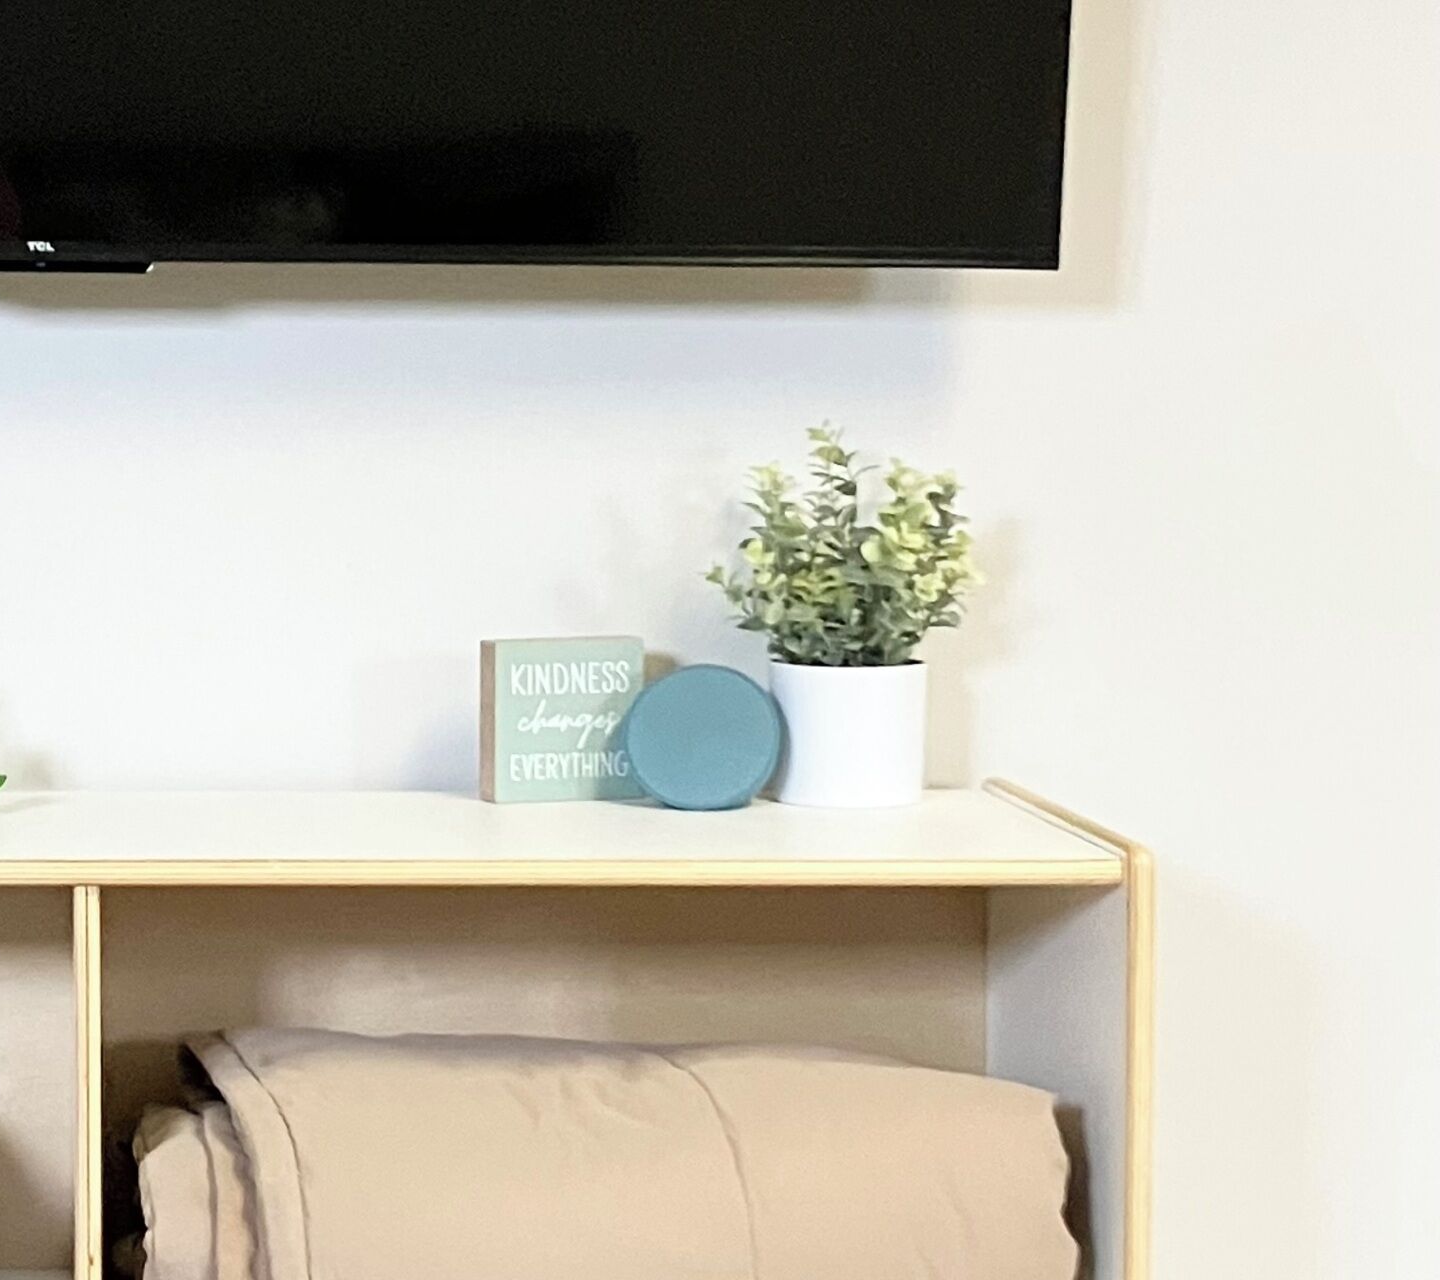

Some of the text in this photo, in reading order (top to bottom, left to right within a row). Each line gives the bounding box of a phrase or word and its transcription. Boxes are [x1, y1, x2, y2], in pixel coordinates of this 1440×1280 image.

[26, 240, 56, 253] TCL
[509, 660, 631, 696] KINDNESS
[516, 699, 618, 750] changes
[509, 750, 630, 782] EVERYTHING
